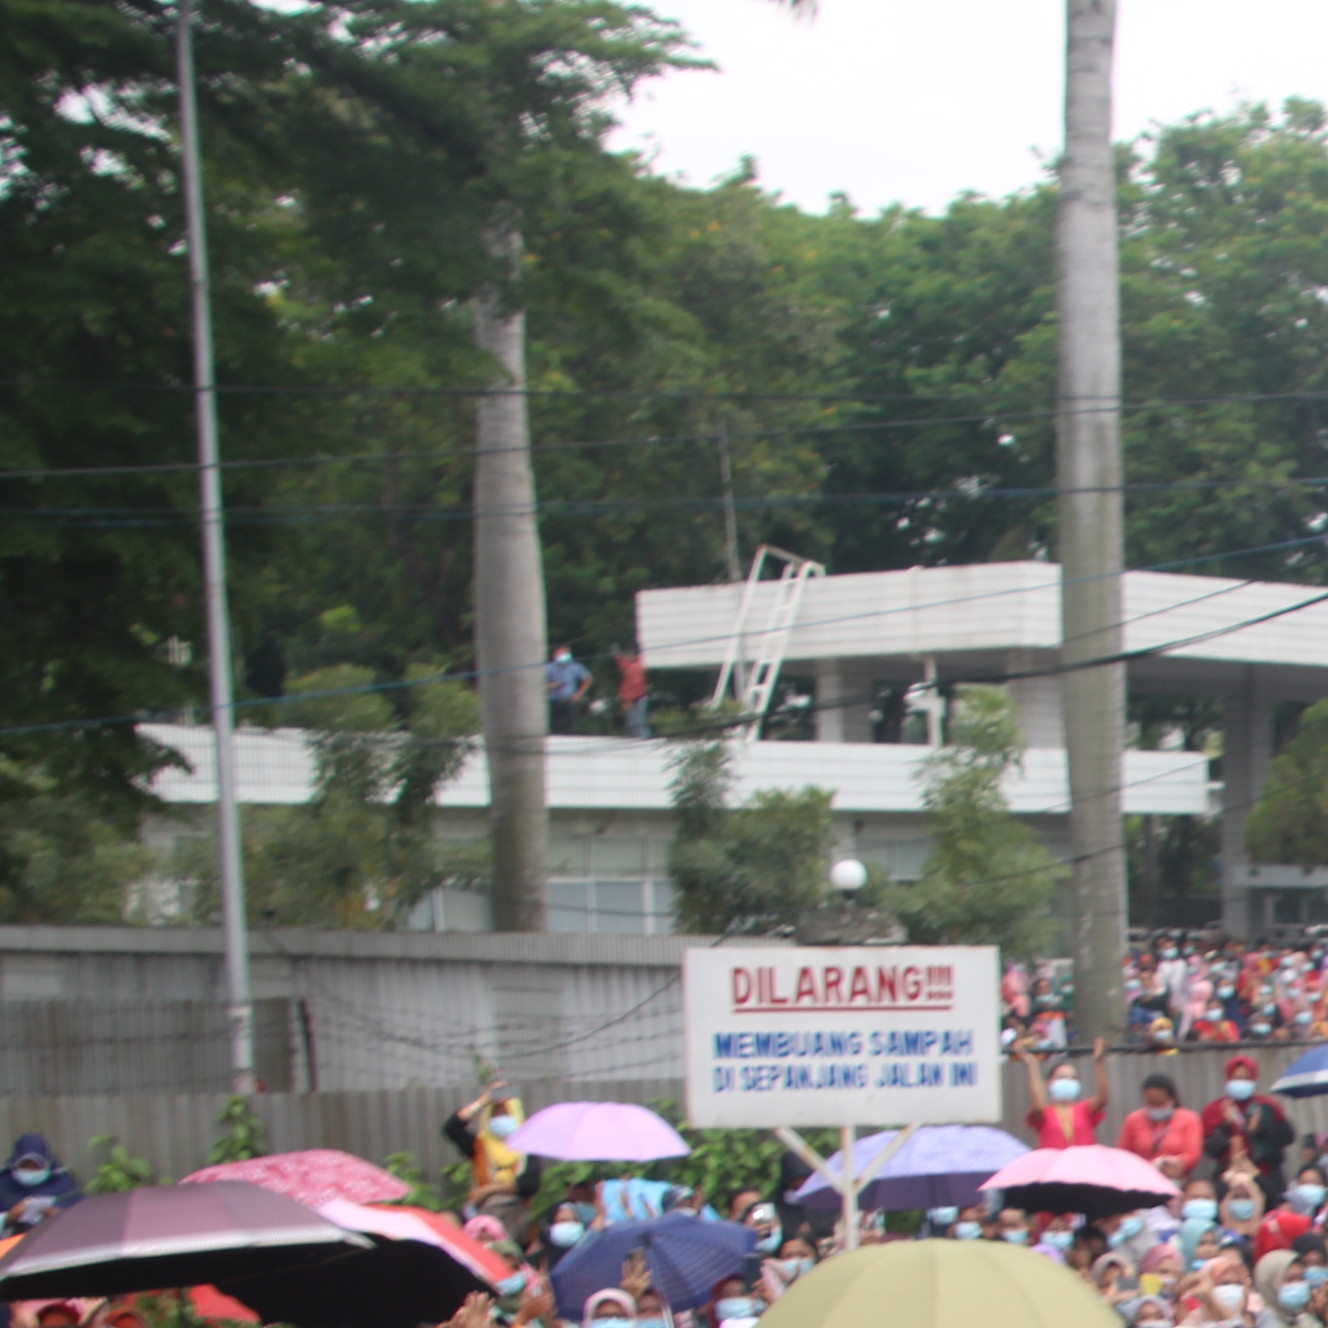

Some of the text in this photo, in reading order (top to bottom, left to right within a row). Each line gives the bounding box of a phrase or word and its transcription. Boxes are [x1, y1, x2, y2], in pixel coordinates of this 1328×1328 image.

[713, 1029, 974, 1059] MEMBUANG SAMPAH
[713, 1061, 978, 1093] DI SEPANJANG JALAN INI
